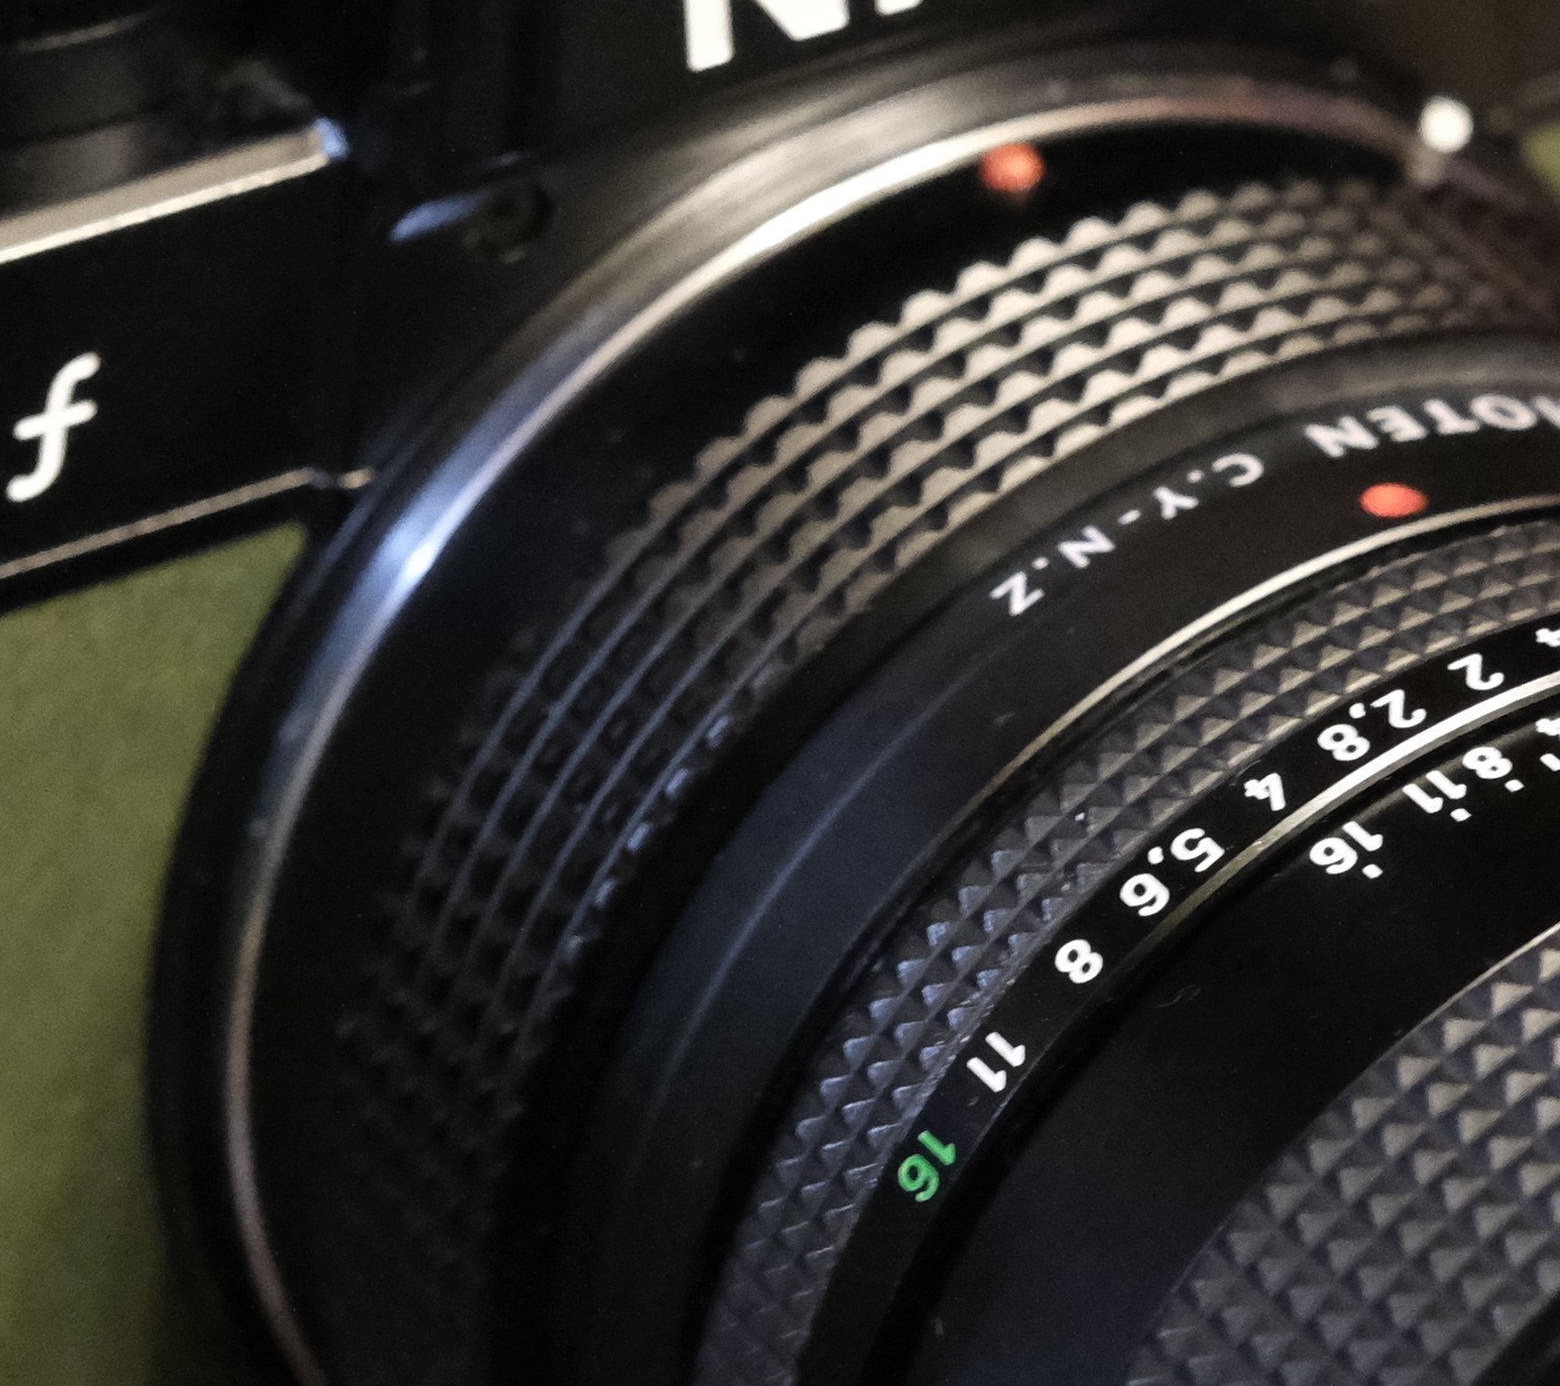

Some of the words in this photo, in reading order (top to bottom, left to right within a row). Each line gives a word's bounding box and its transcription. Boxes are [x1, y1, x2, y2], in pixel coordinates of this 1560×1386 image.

[1447, 652, 1506, 693] 2
[1461, 745, 1513, 781] 8
[1244, 771, 1287, 812] 4
[1402, 769, 1468, 813] 11
[1309, 820, 1384, 875] 16
[1054, 939, 1104, 984] 8
[966, 1031, 1026, 1093] 11
[897, 1130, 956, 1202] 16
